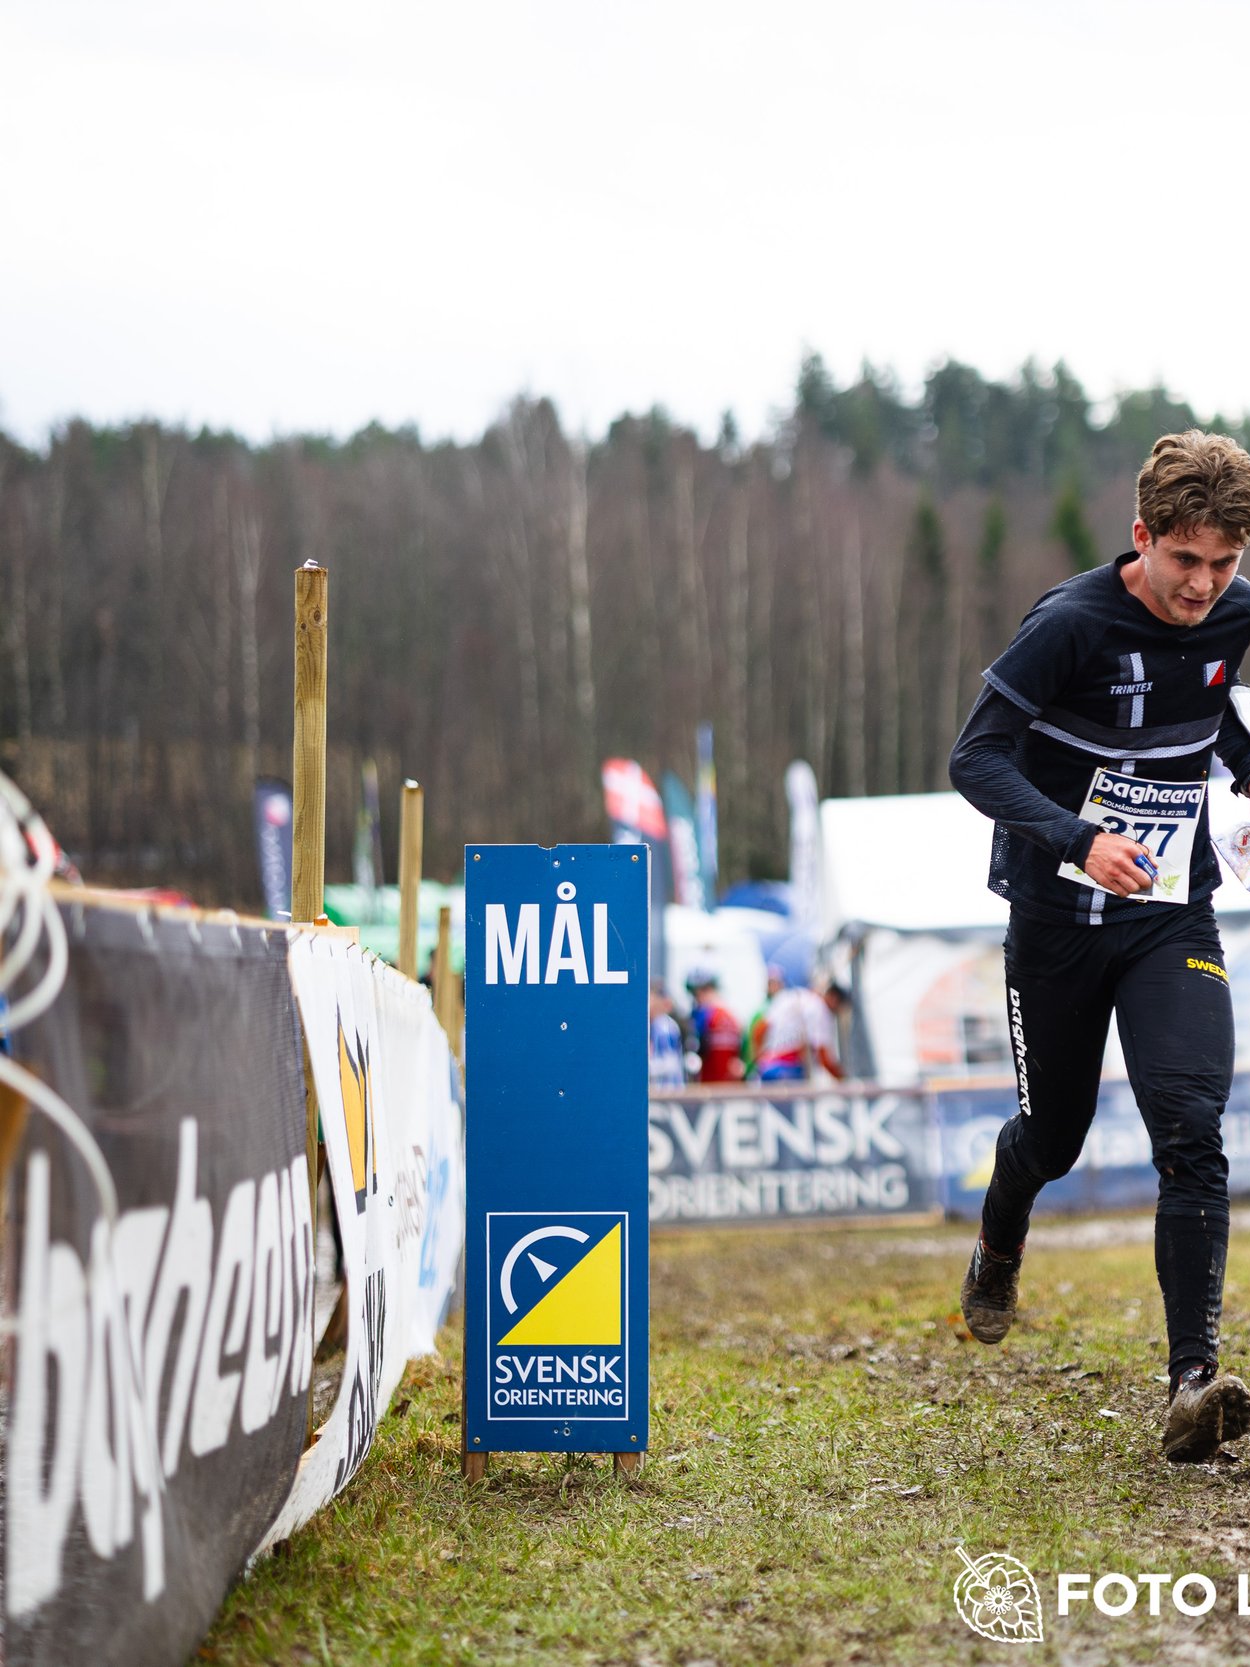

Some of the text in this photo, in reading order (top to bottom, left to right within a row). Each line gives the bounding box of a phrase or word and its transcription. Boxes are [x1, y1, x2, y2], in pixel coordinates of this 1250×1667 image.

[1110, 682, 1153, 695] TRIMTEX
[1095, 774, 1202, 804] bagheera
[485, 881, 629, 985] MÅL
[495, 1355, 622, 1384] SVENSK
[494, 1388, 623, 1406] ORIENTERING
